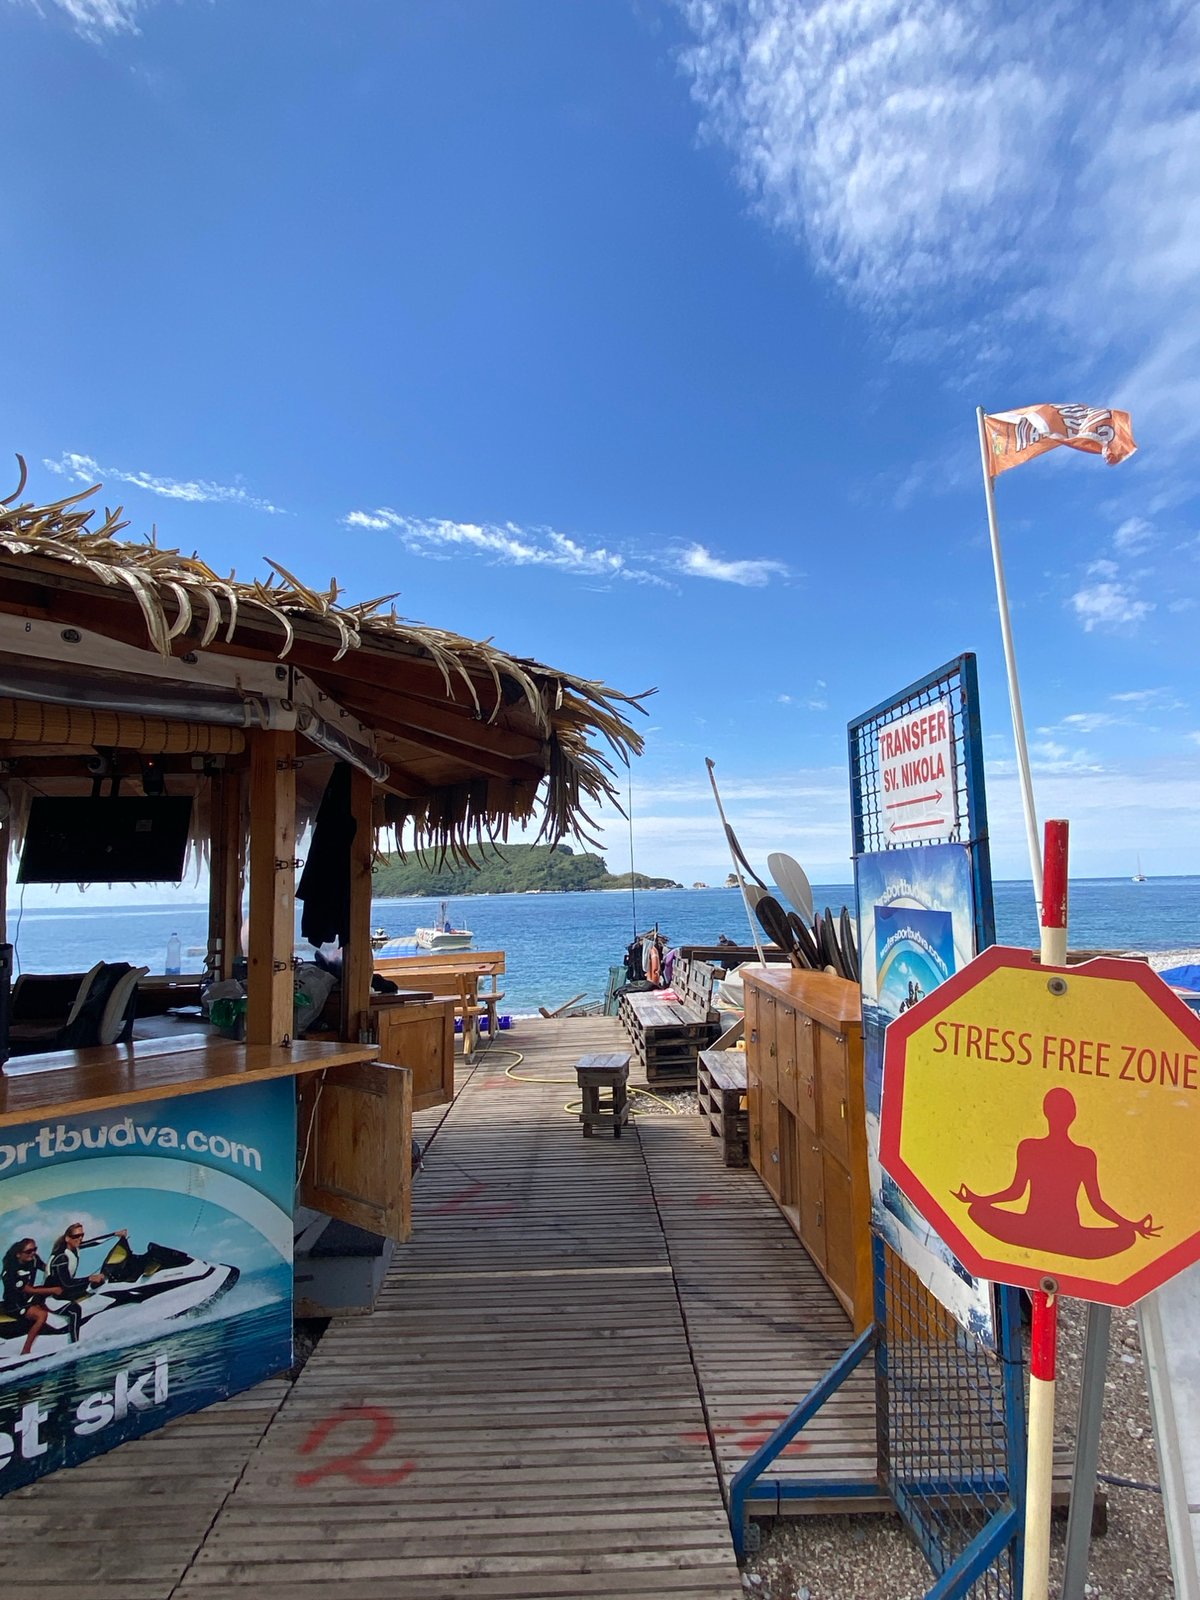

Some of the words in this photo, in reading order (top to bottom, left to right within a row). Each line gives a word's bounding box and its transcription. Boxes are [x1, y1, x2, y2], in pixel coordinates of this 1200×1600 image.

[880, 709, 947, 761] TRANSFER
[883, 769, 899, 793] SV.
[901, 752, 945, 788] NIKOLA
[880, 926, 949, 977] watersportbudva.com
[932, 1021, 1032, 1066] STRESS
[1042, 1035, 1111, 1078] FREE
[1118, 1046, 1199, 1090] ZONE
